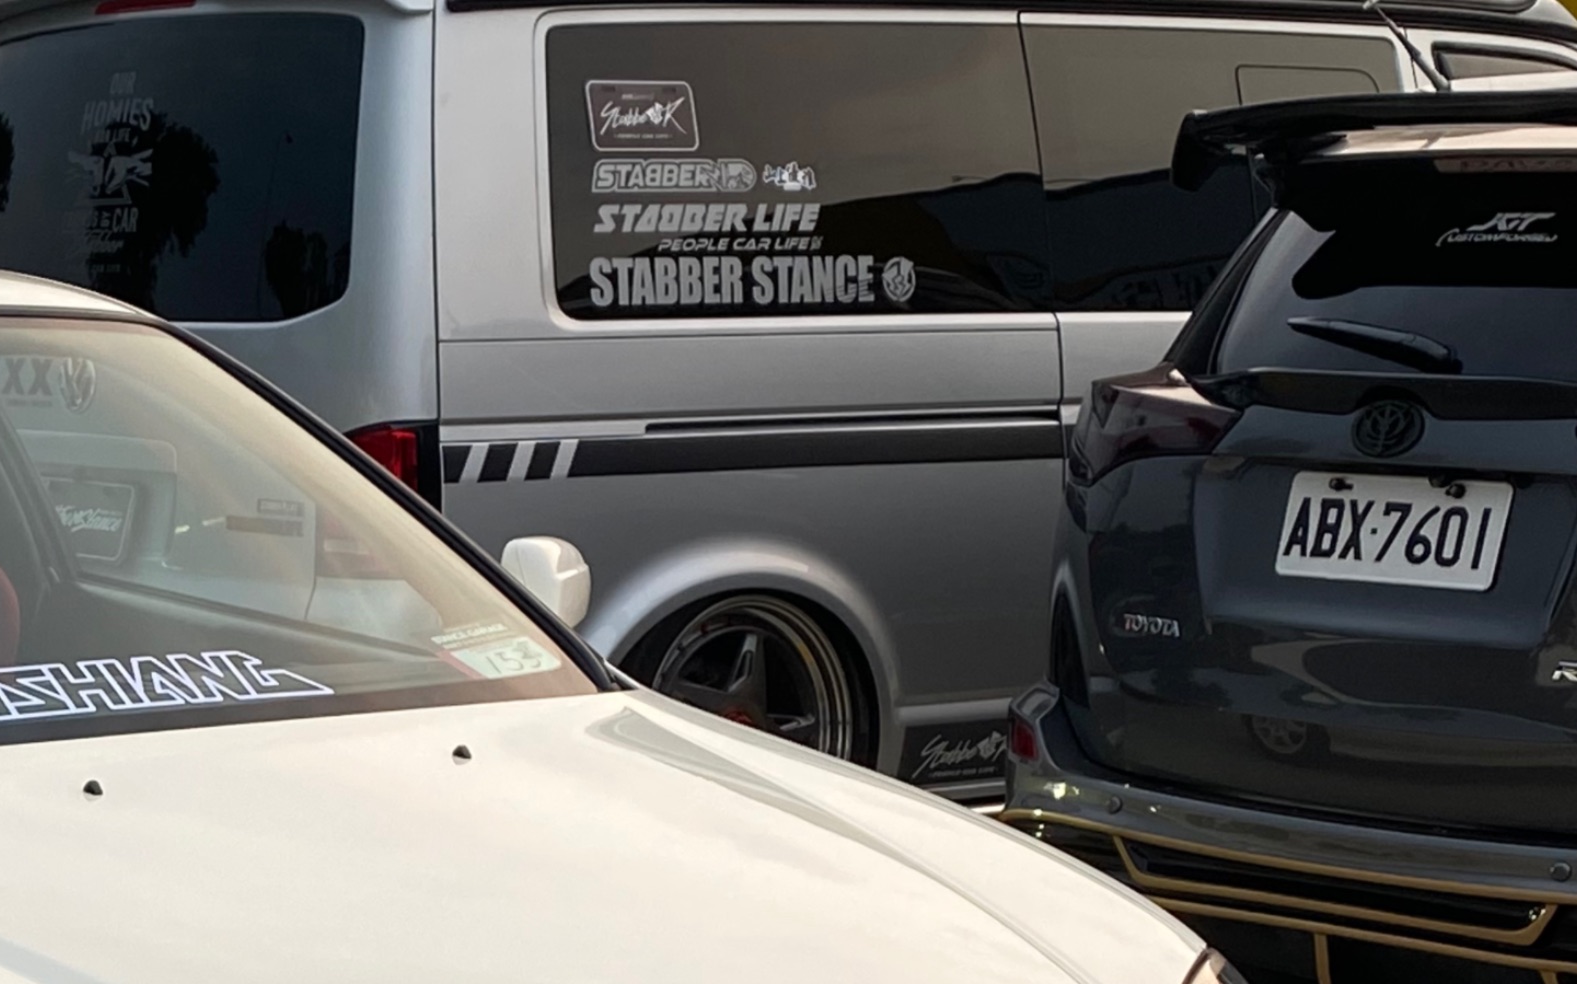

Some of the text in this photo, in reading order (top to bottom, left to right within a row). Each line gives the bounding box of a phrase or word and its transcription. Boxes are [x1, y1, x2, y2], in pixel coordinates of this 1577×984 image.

[80, 97, 155, 135] HOMIES
[111, 206, 139, 233] CAR
[593, 203, 821, 233] STABBER LIFE
[657, 236, 810, 252] PEOPLE CAR LIFE
[589, 254, 876, 307] STABBER STANCE
[1123, 613, 1181, 638] TOYOTA
